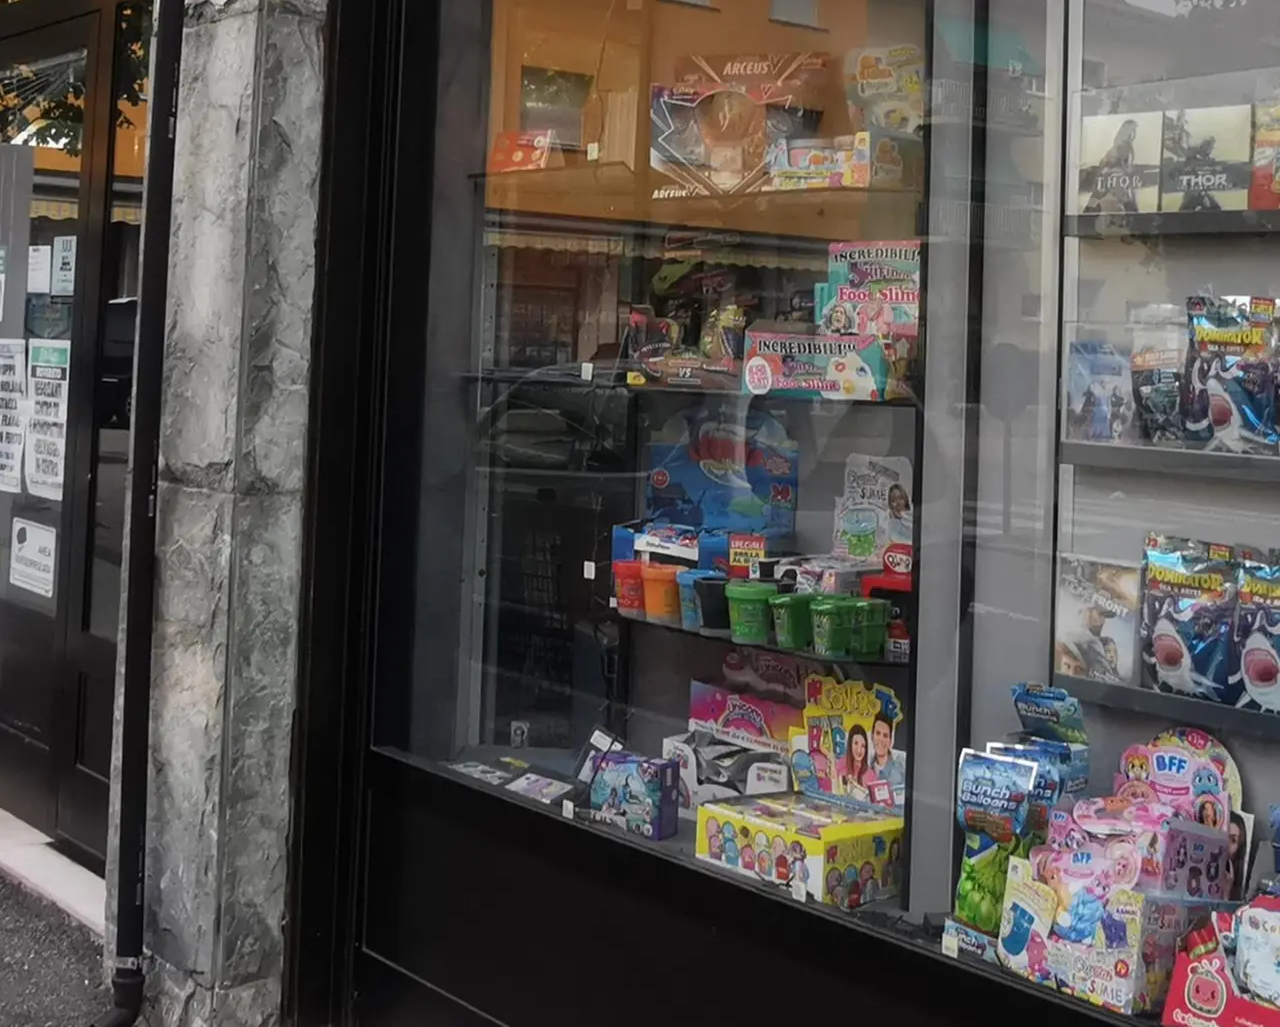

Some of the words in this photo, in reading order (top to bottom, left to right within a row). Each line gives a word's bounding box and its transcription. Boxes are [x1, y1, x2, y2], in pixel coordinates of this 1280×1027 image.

[723, 61, 770, 76] ARCEUS
[1096, 175, 1143, 191] THOR
[1179, 173, 1228, 188] THOR
[1153, 754, 1189, 774] BFF
[961, 779, 1011, 800] Bunch
[960, 792, 1018, 811] Balloons
[1072, 851, 1092, 865] BFF
